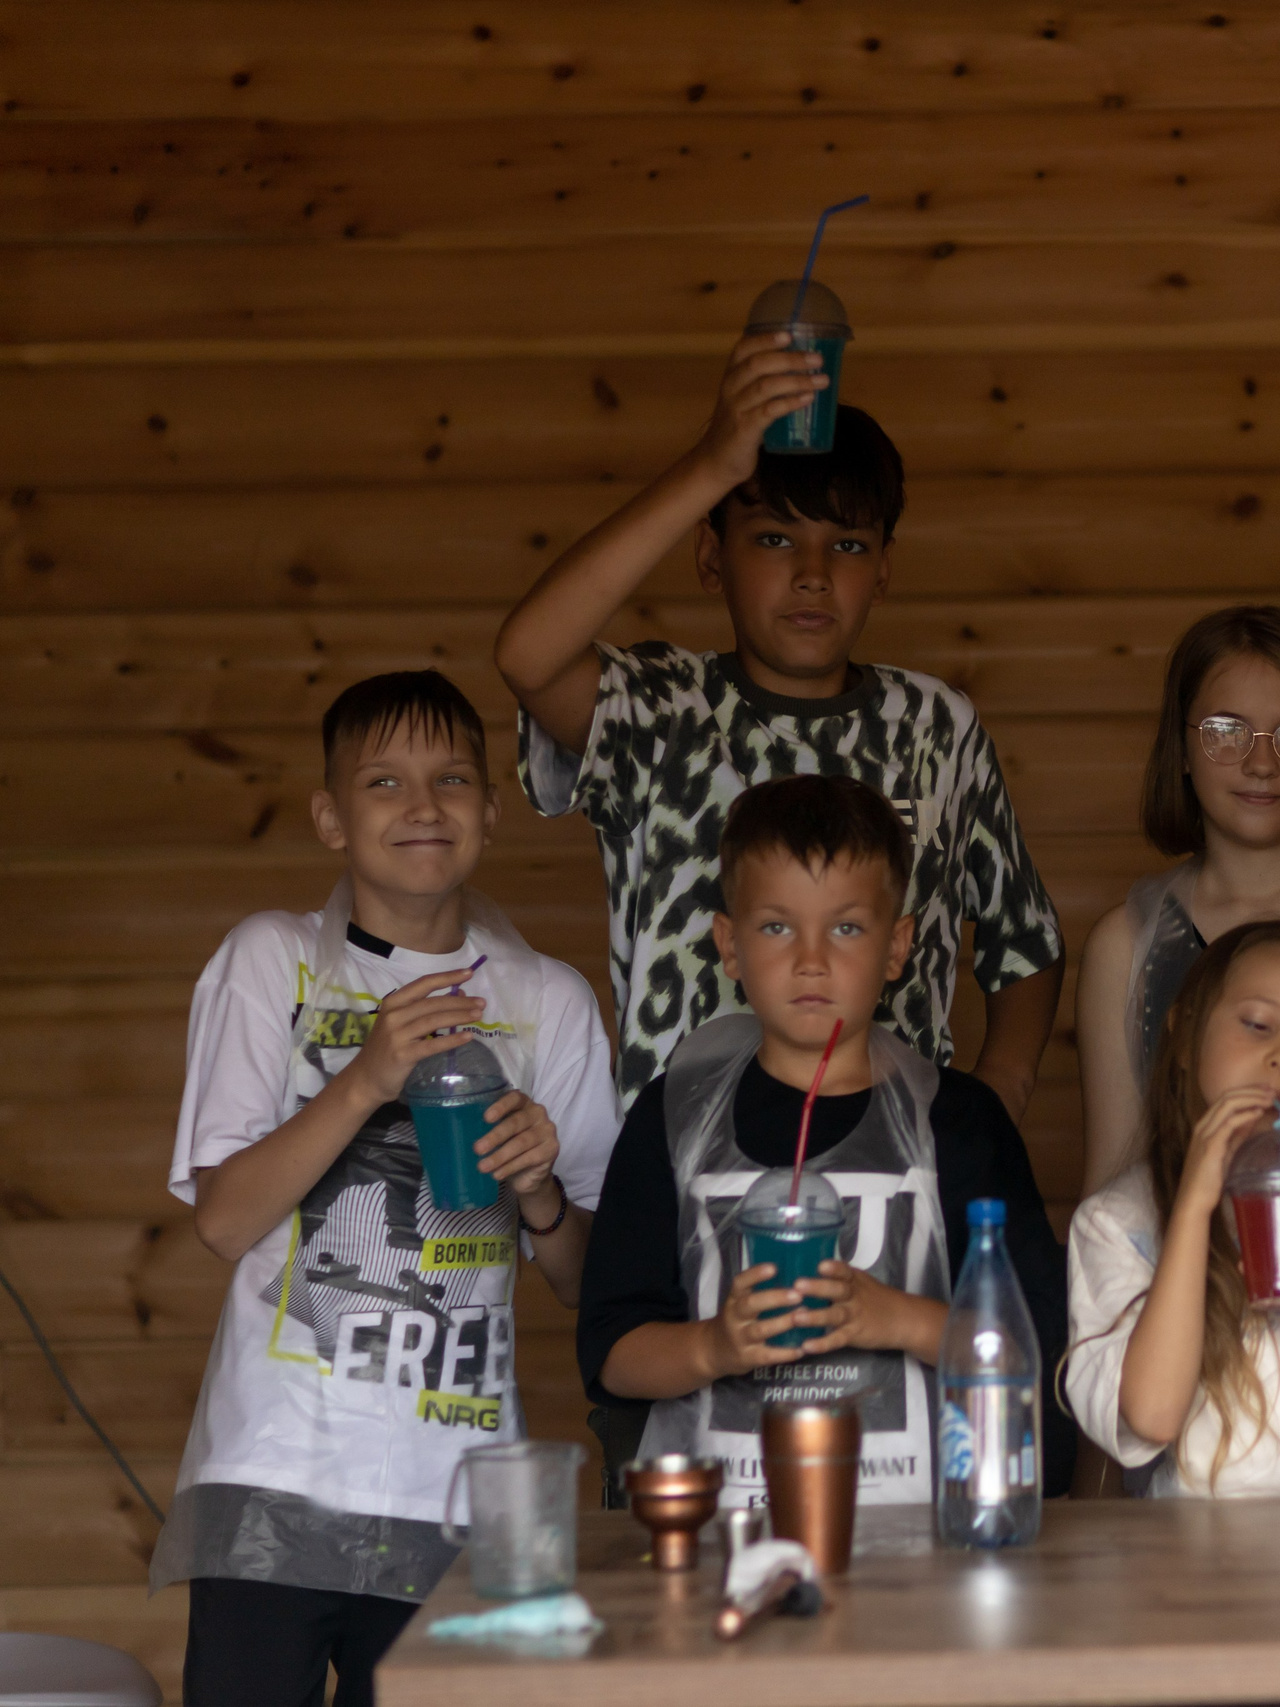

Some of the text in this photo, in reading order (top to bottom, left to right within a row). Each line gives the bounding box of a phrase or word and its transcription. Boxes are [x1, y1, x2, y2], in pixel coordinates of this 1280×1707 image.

[433, 1242, 478, 1264] BORN
[481, 1242, 497, 1262] TO
[332, 1304, 513, 1394] FREE
[753, 1363, 859, 1381] BE FREE FROM
[763, 1386, 845, 1402] PREJUDICE
[422, 1399, 501, 1432] NRG
[859, 1455, 918, 1478] WANT
